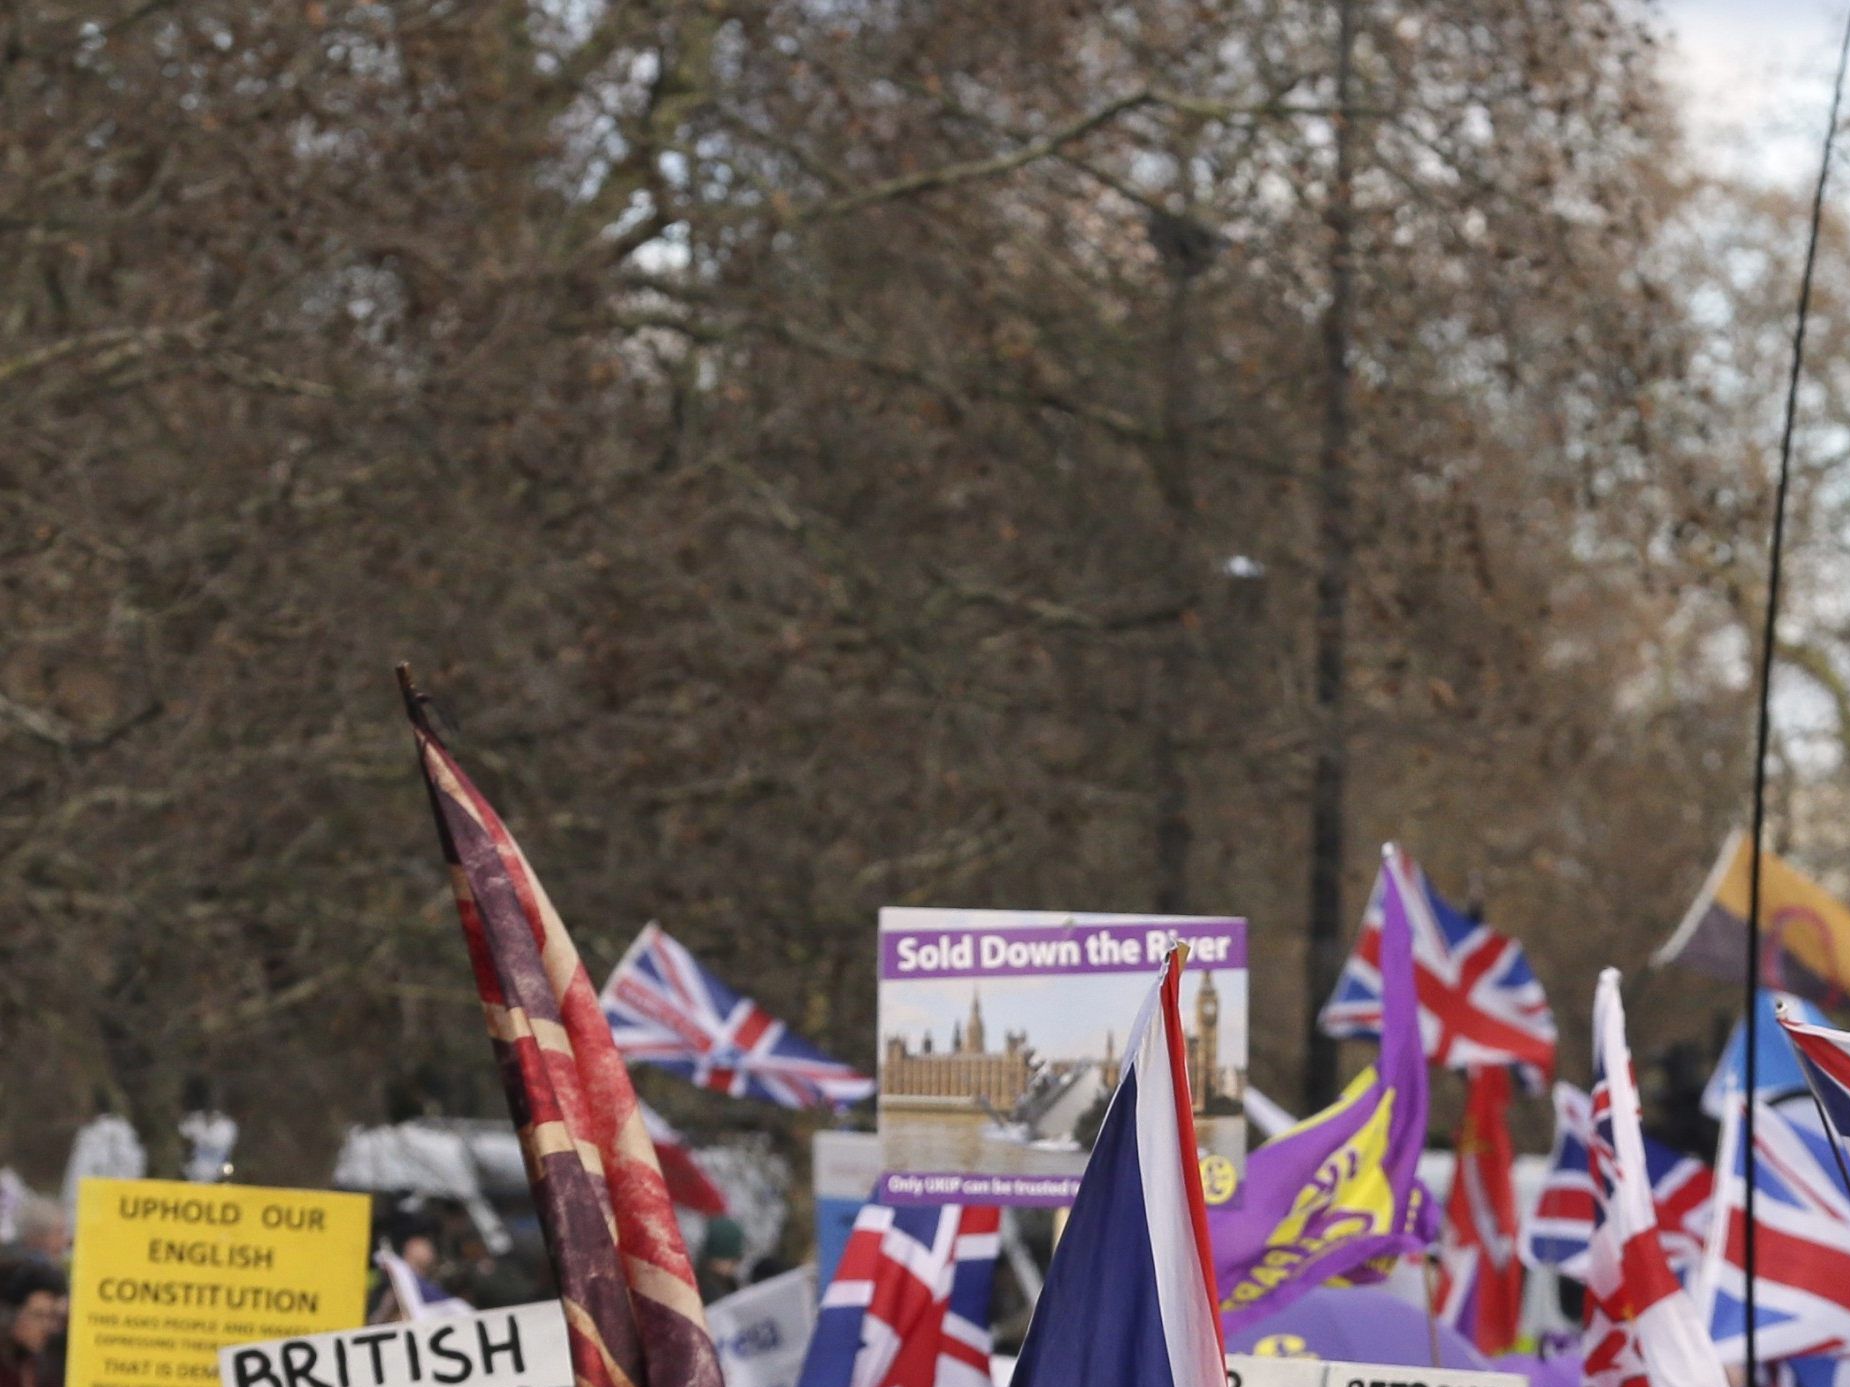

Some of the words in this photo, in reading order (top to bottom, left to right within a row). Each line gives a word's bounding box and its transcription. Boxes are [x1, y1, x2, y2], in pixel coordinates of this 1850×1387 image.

[897, 935, 968, 972] Sold
[979, 931, 1077, 970] Down
[1086, 930, 1139, 966] the
[119, 1195, 242, 1226] UPHOLD
[261, 1204, 327, 1231] OUR
[148, 1237, 274, 1270] ENGLISH
[98, 1277, 319, 1314] CONSTITUTION
